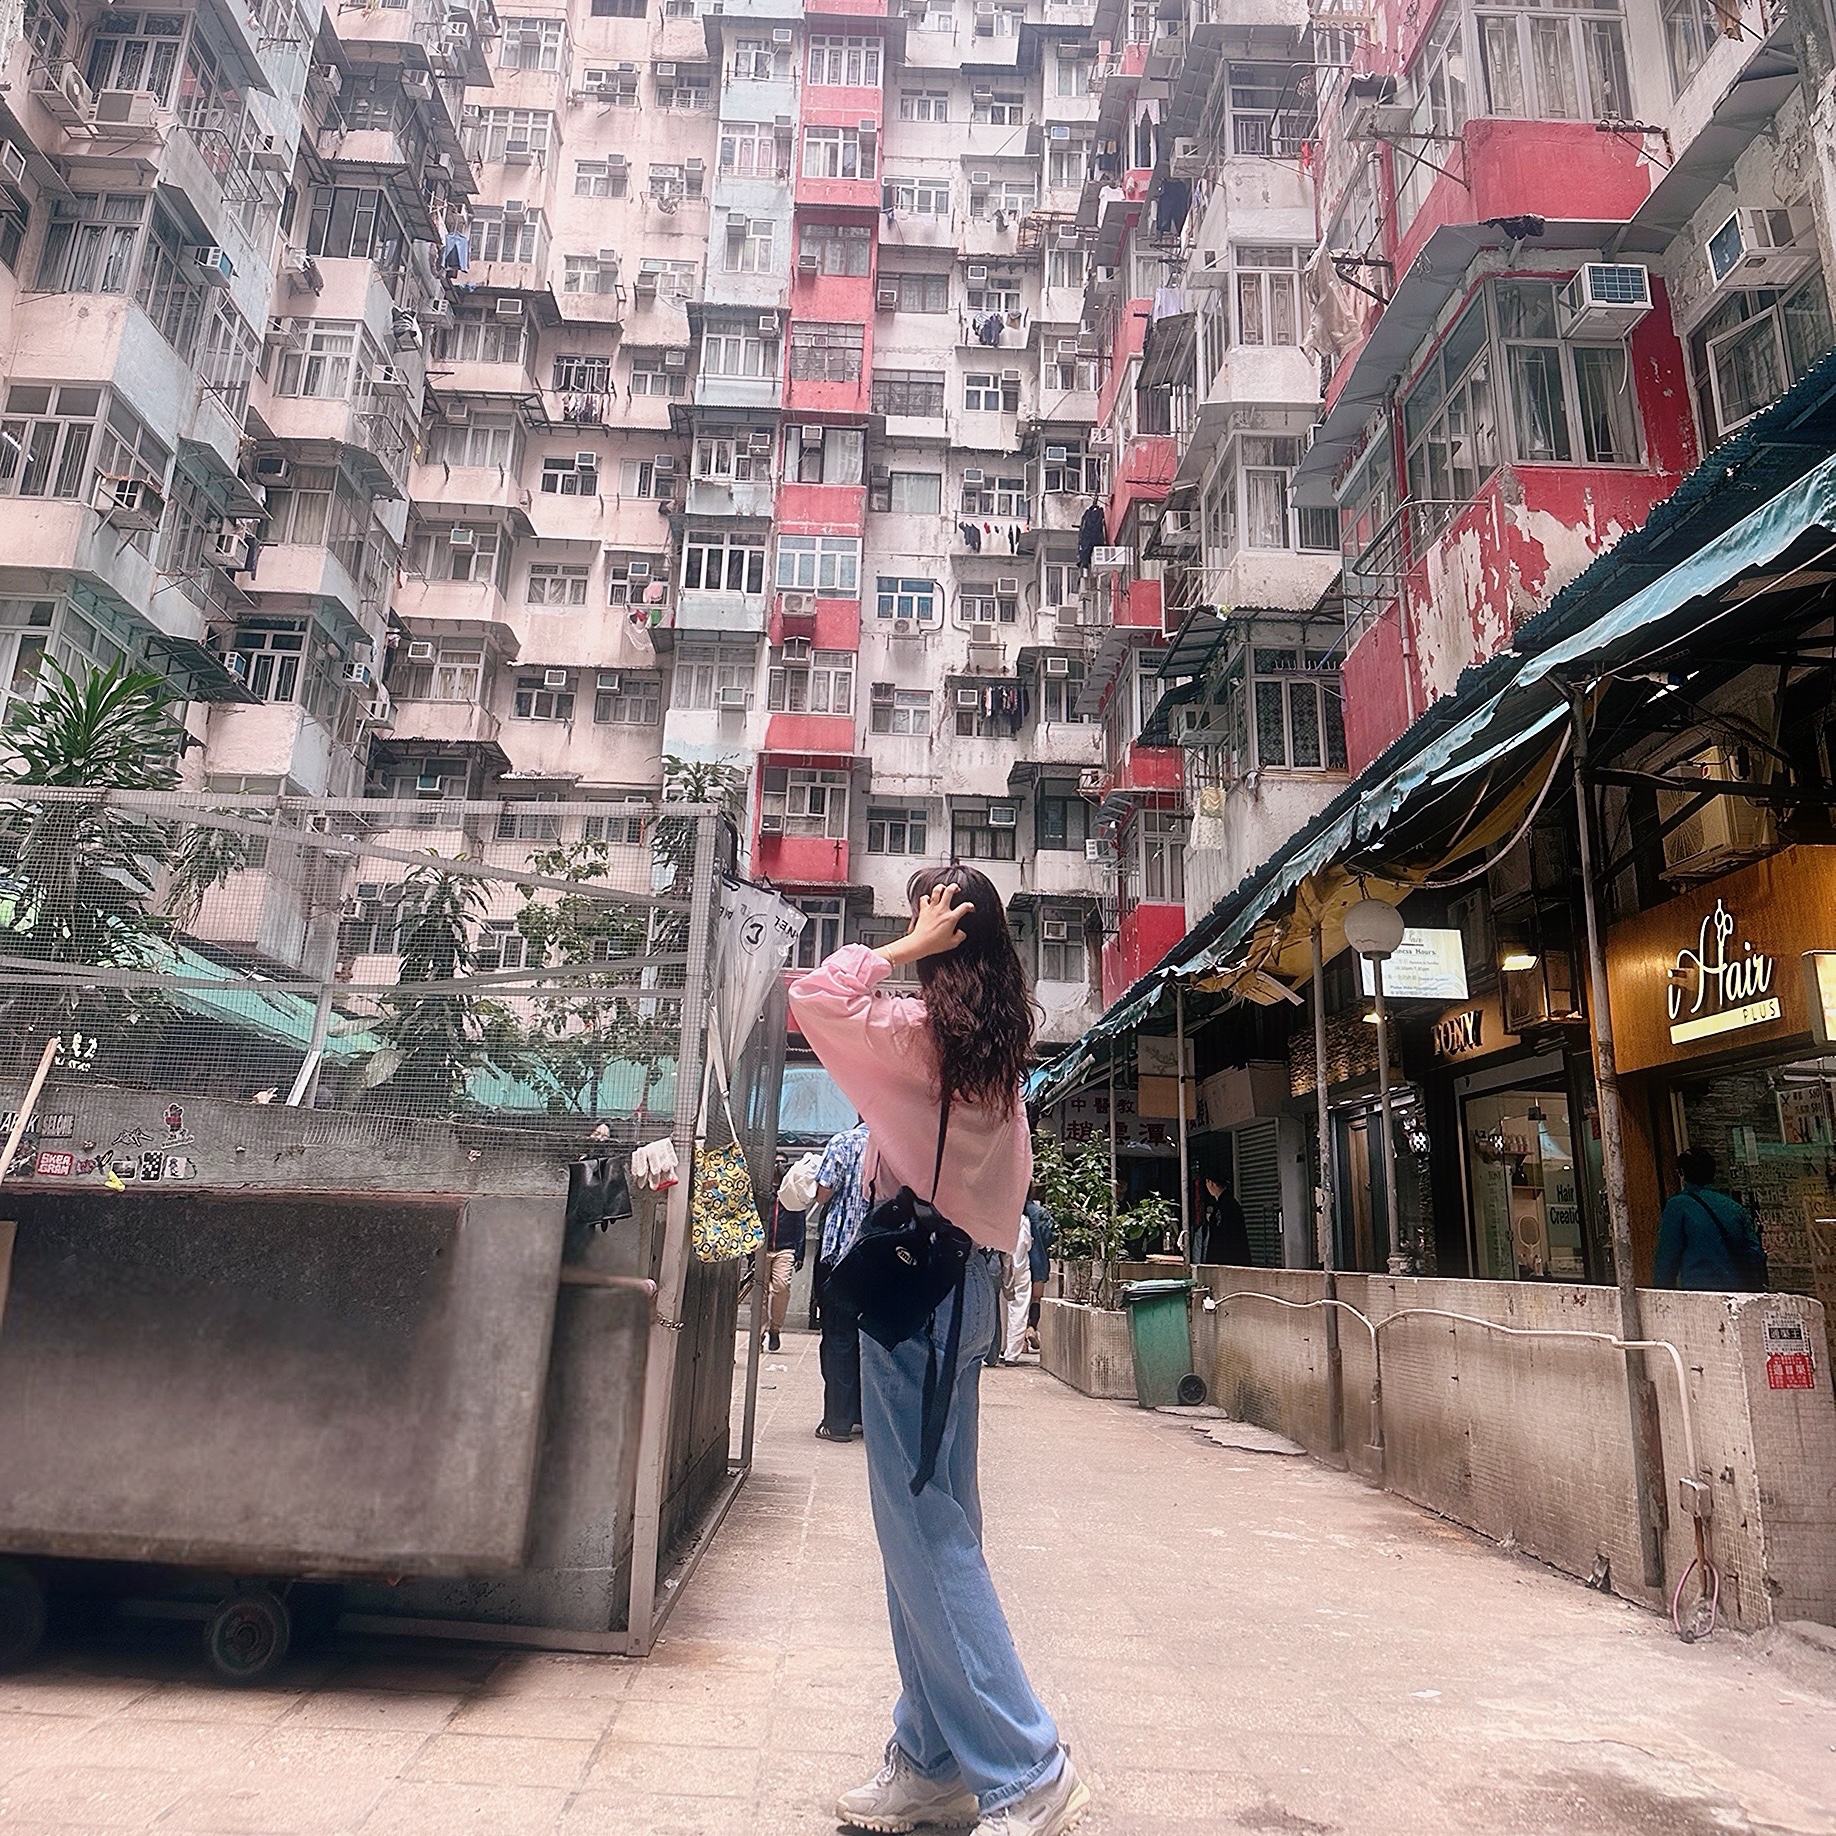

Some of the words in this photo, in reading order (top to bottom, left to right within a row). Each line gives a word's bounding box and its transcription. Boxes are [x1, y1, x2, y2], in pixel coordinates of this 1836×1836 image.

[1742, 1001, 1776, 1023] PLUS
[1431, 1010, 1479, 1056] TONY
[1556, 1183, 1575, 1203] Hair
[1550, 1205, 1580, 1225] Creatio
